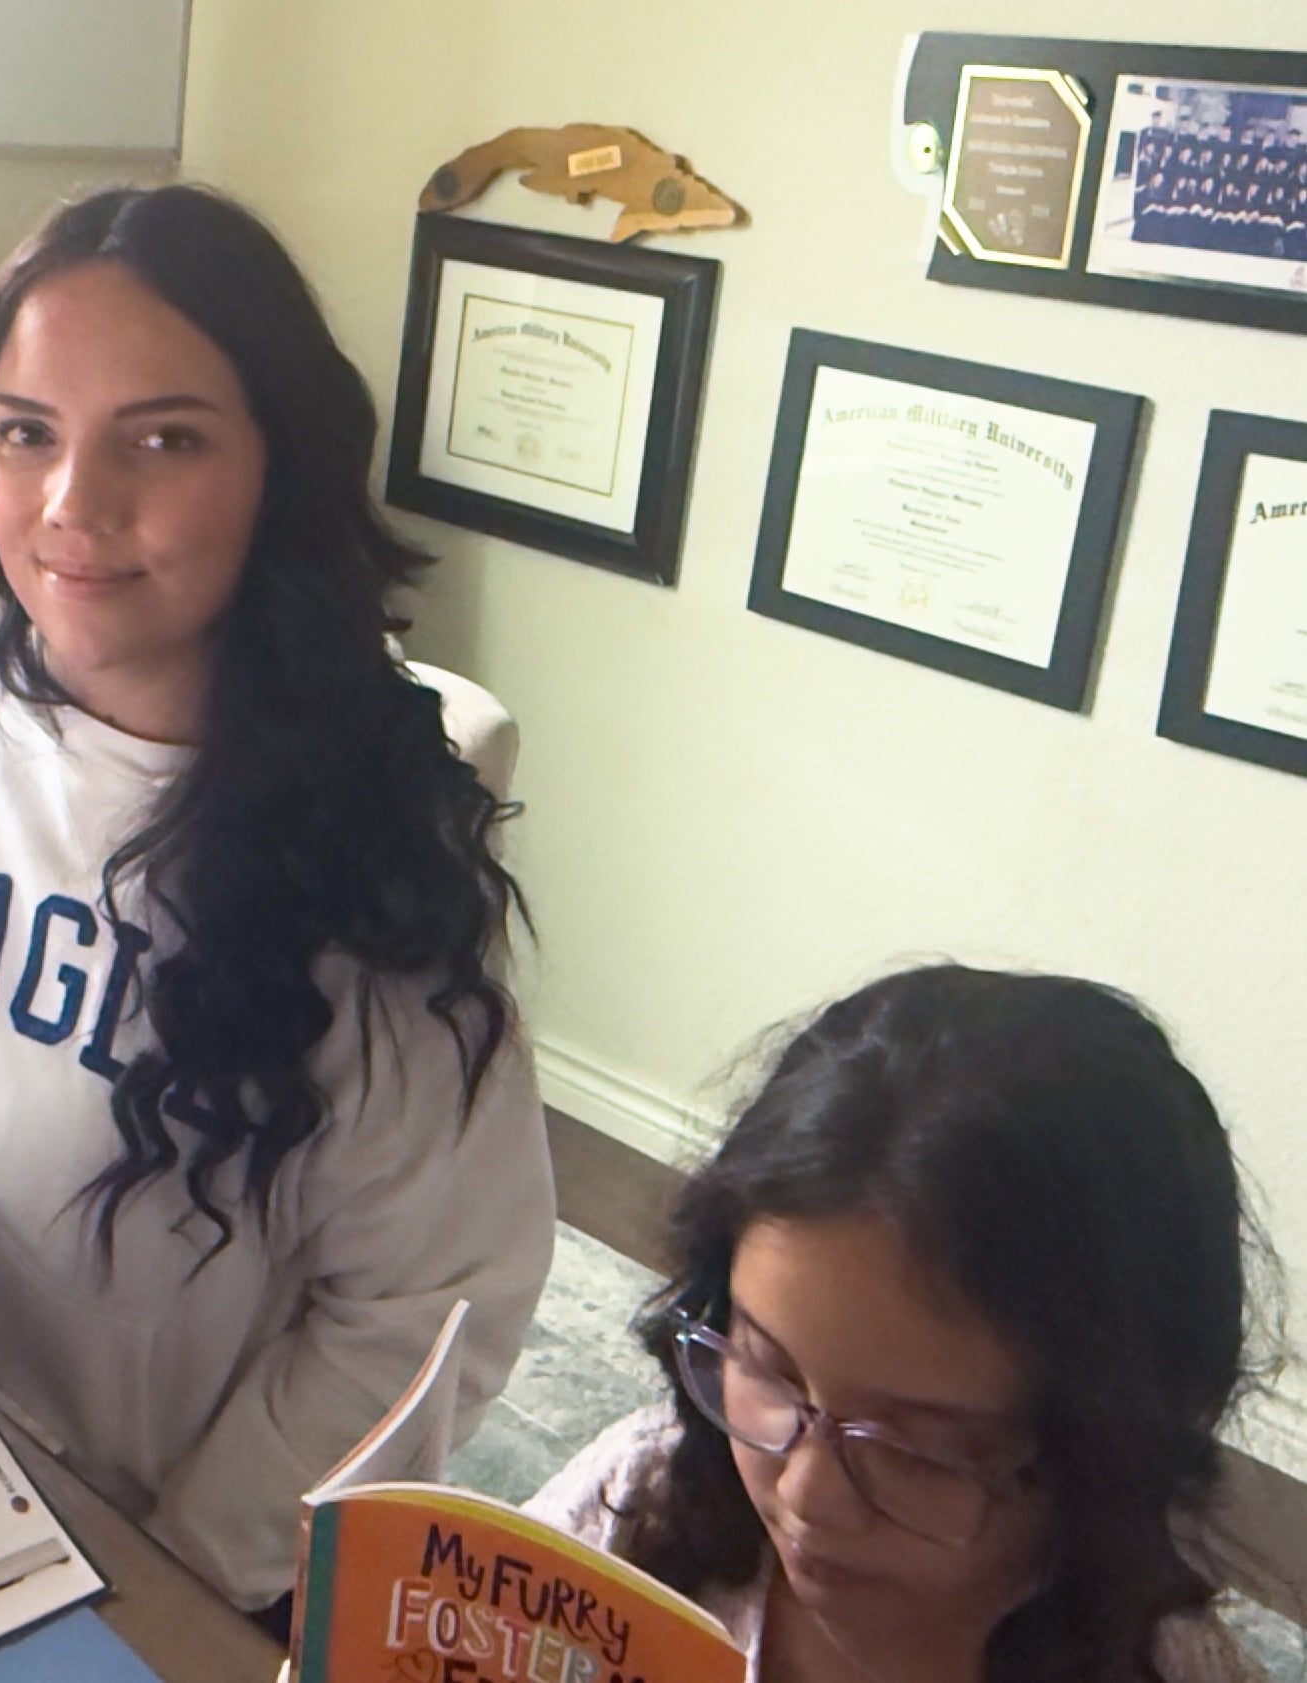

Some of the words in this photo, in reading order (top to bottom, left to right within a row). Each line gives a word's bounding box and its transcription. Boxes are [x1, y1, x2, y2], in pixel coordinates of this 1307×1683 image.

[821, 404, 899, 427] American
[906, 403, 979, 439] Military
[985, 420, 1075, 490] University
[420, 1521, 485, 1602] My
[386, 1576, 600, 1683] FOSTER
